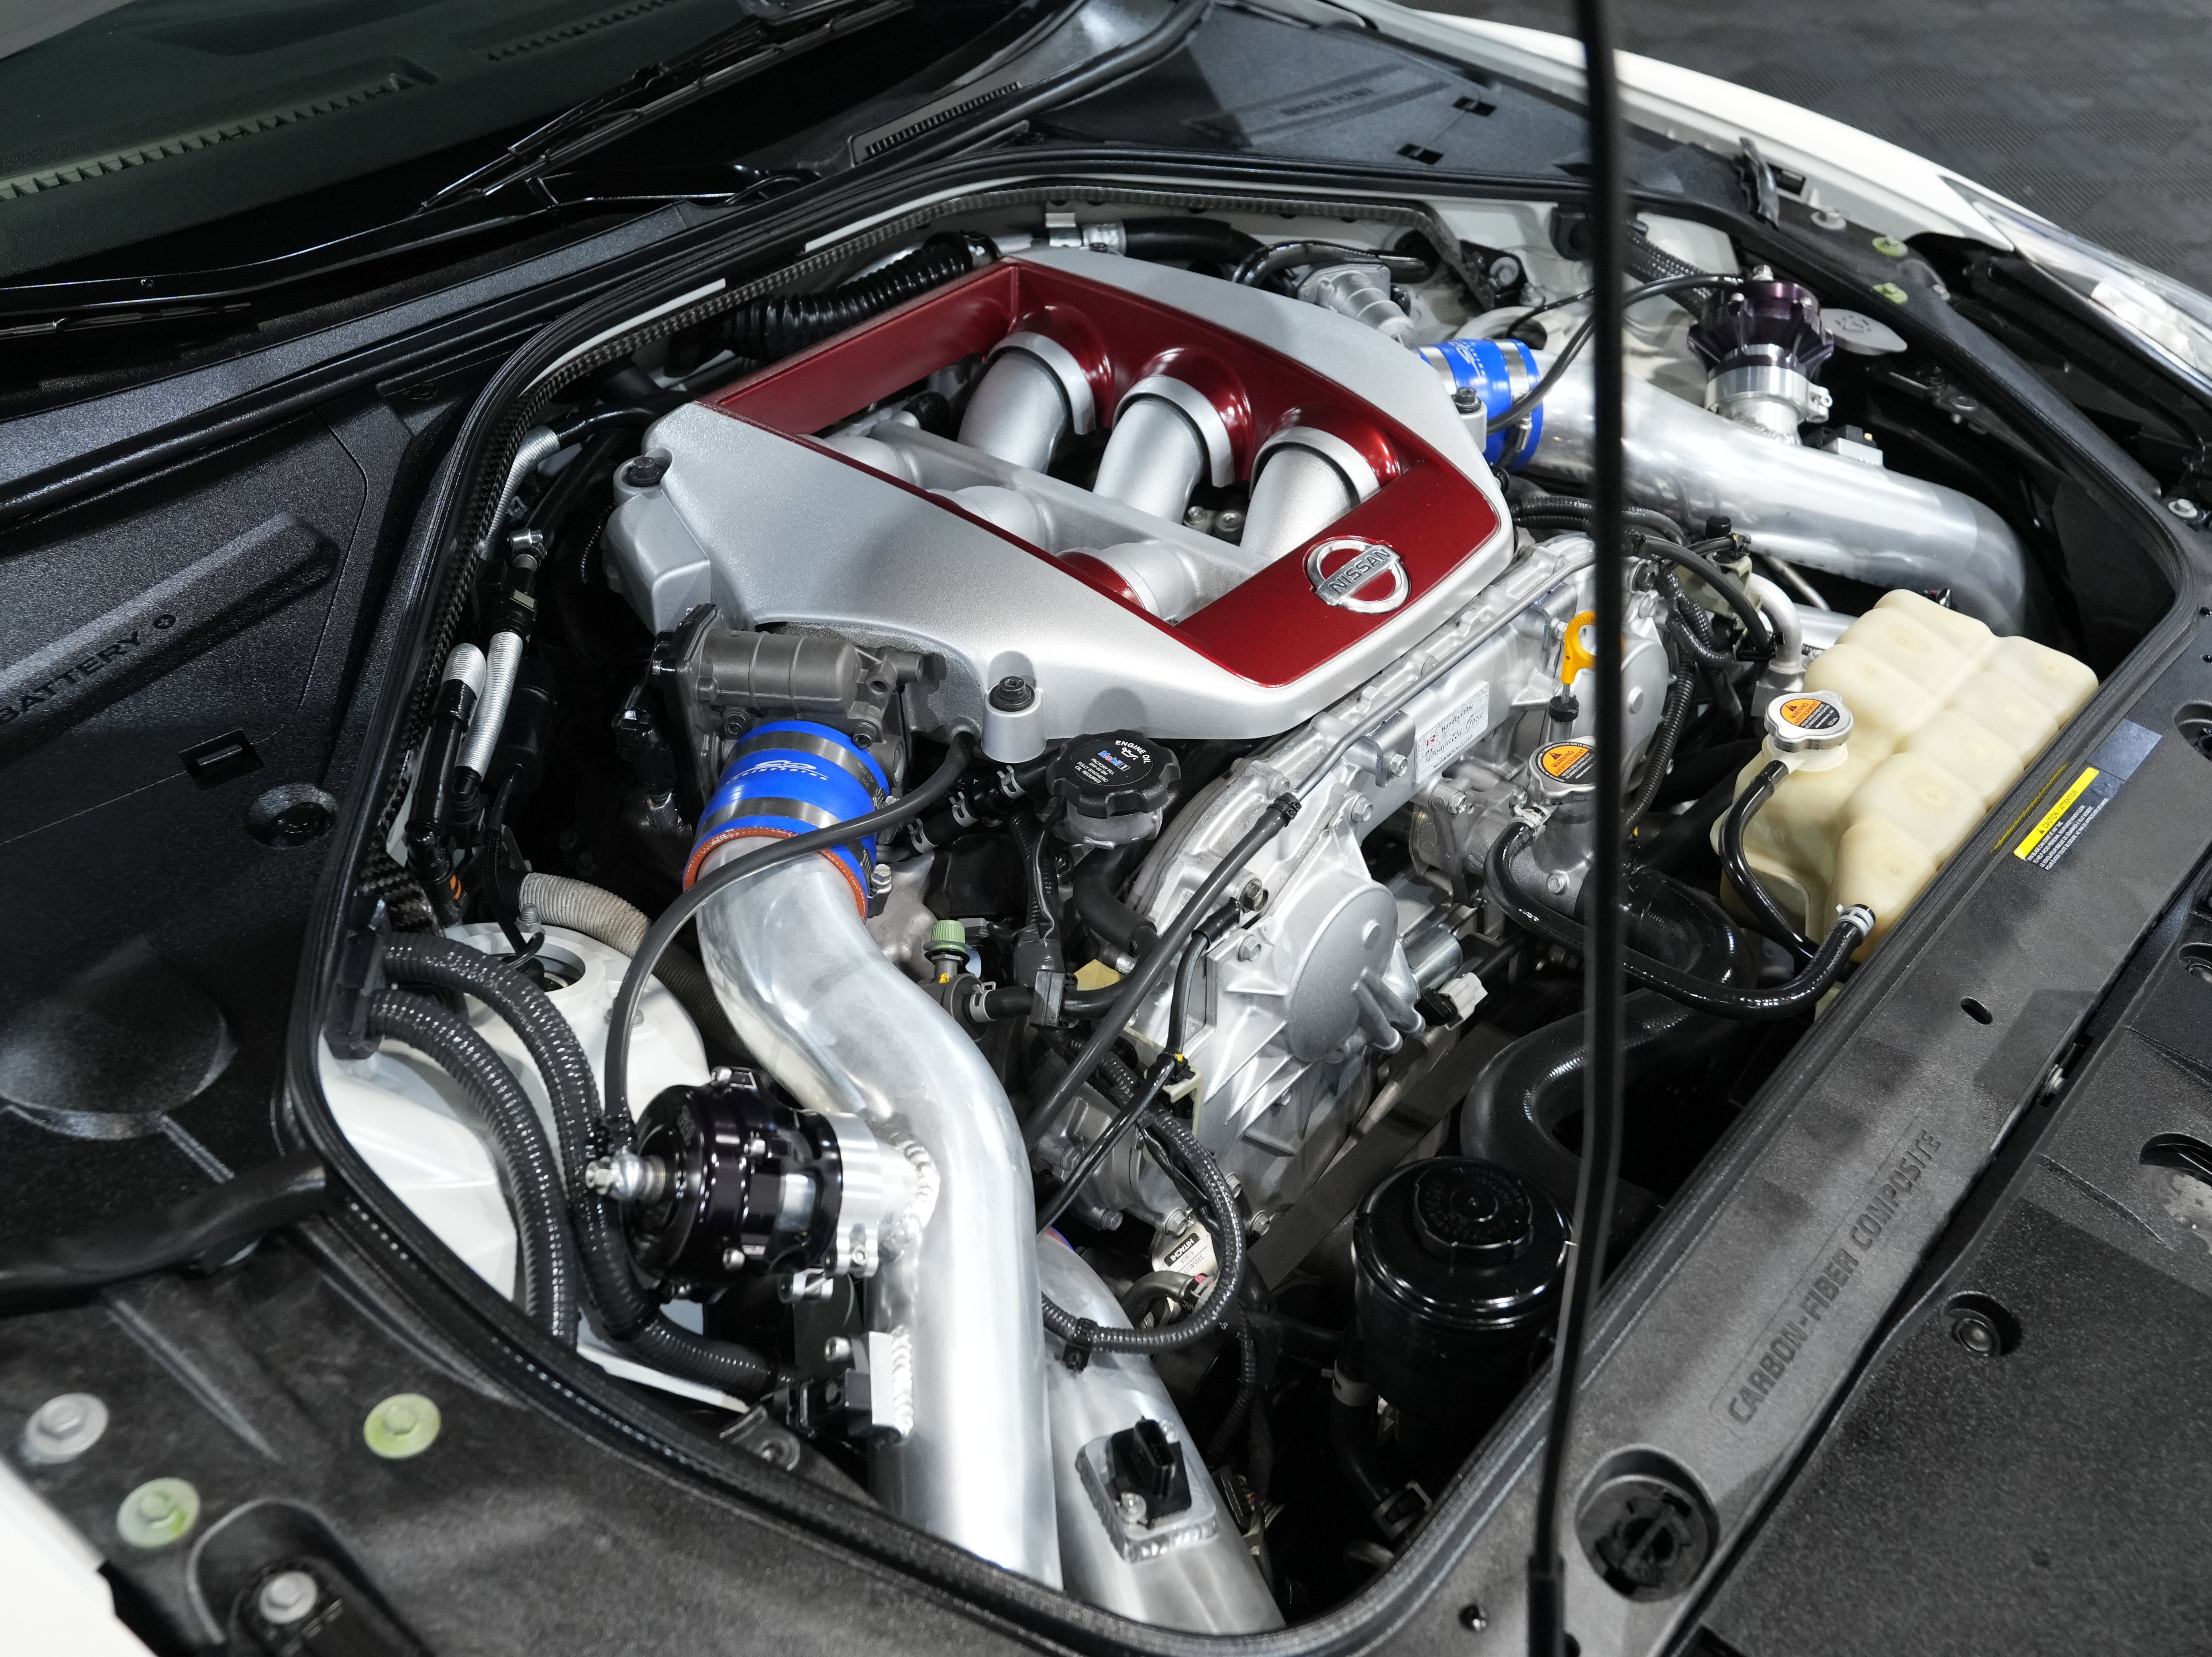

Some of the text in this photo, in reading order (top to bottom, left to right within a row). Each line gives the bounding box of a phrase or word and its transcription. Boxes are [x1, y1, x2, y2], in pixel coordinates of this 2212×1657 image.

[1328, 548, 1392, 593] NISSAN
[0, 631, 141, 725] BATTERY
[1441, 710, 1465, 732] Handbuilt
[1789, 702, 1809, 719] WARNING
[1794, 701, 1818, 724] AVERTISSEMENT
[1098, 750, 1123, 766] Mobil
[1115, 740, 1151, 764] ENGINE OIL
[1433, 756, 1446, 769] NISSAN
[1447, 745, 1460, 757] MOTOR
[1551, 750, 1575, 768] WARNING
[1555, 749, 1585, 774] AVERTISSEMENT
[1088, 768, 1109, 783] SYNTHETIC
[1089, 763, 1102, 772] 0W-40
[1091, 758, 1109, 770] FACTORY
[1082, 770, 1101, 783] REQUIRED
[2042, 812, 2059, 828] CAUTION
[2058, 791, 2078, 809] ATTENTION
[2042, 848, 2057, 864] VENTILATEUR
[2055, 840, 2065, 848] RISQUE
[2064, 824, 2078, 836] DÉMARRER
[2047, 834, 2061, 846] PERSONAL
[2050, 854, 2061, 863] ÉVITER
[2085, 810, 2099, 824] APPROCHER
[1170, 1238, 1195, 1261] HITACHI
[1729, 1128, 1941, 1424] CARBON-FIBER COMPOSITE
